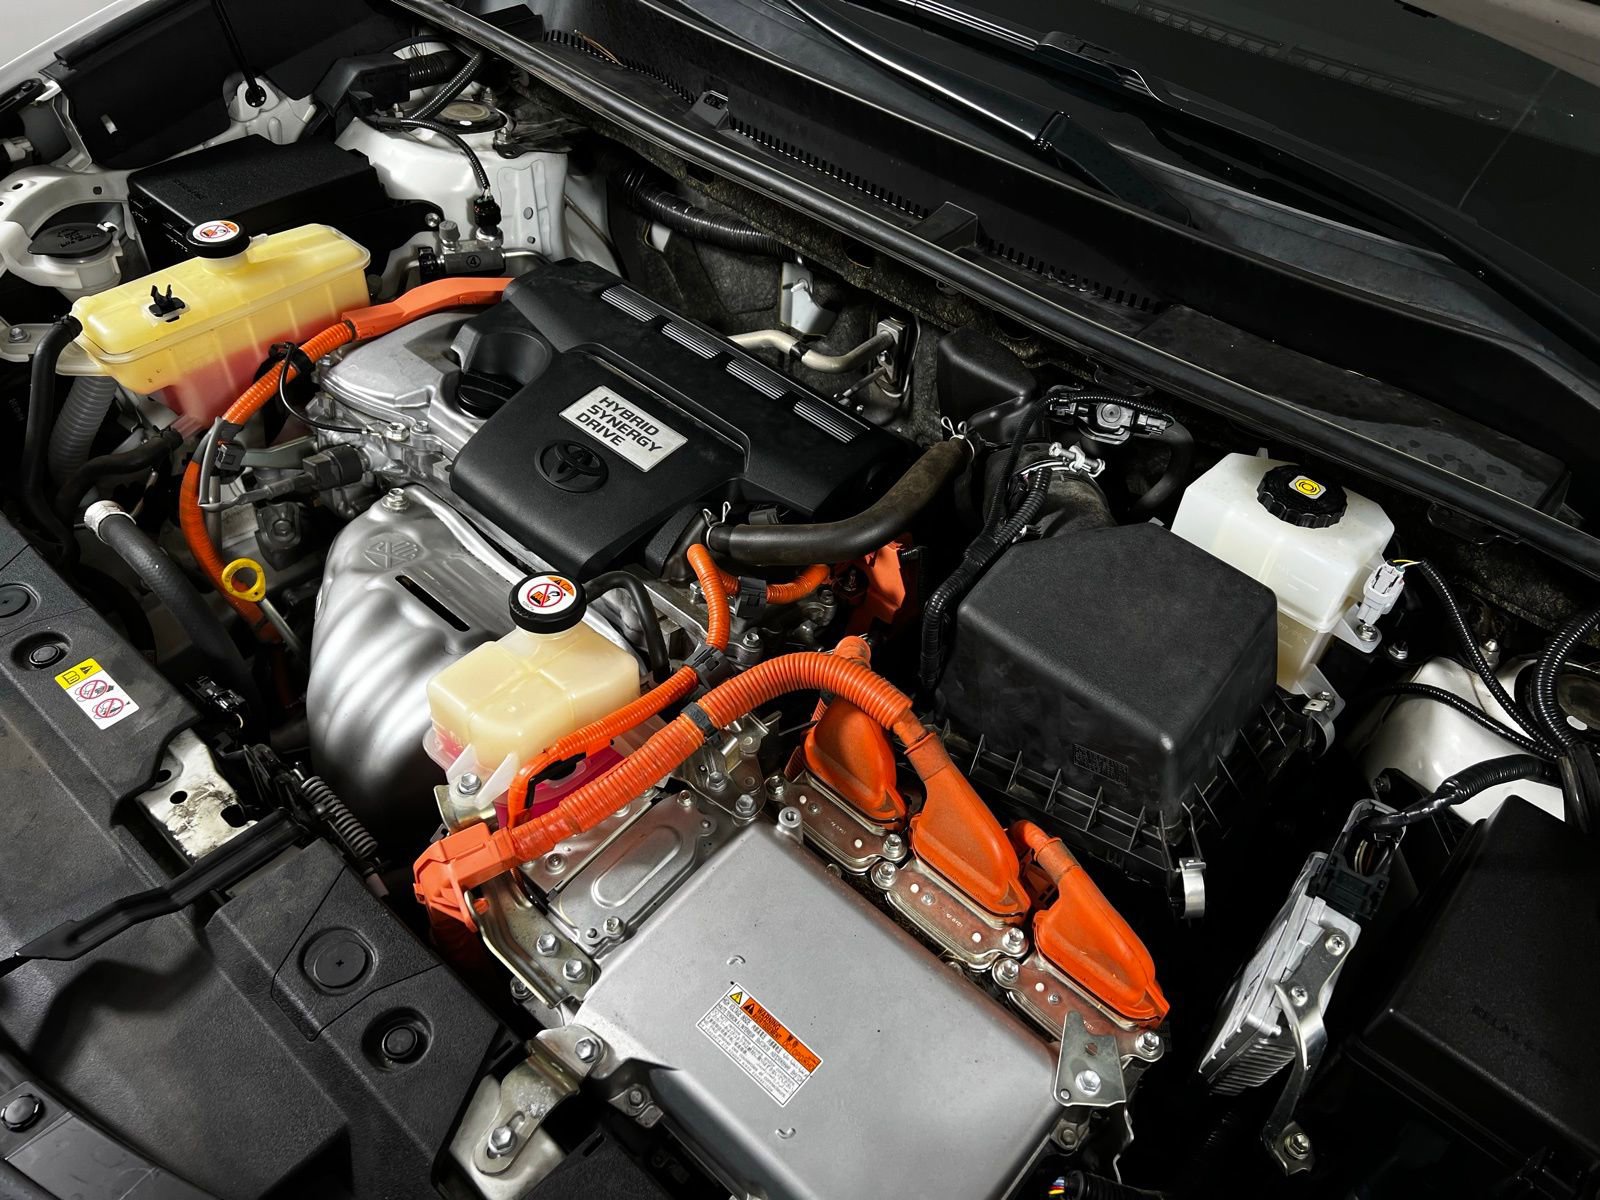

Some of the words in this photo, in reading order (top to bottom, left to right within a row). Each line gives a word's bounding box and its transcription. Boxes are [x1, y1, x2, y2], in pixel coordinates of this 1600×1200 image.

[575, 412, 626, 446] DRIVE
[587, 405, 662, 452] SYNERGY
[599, 396, 659, 436] HYBRID
[756, 1007, 781, 1031] WARNING
